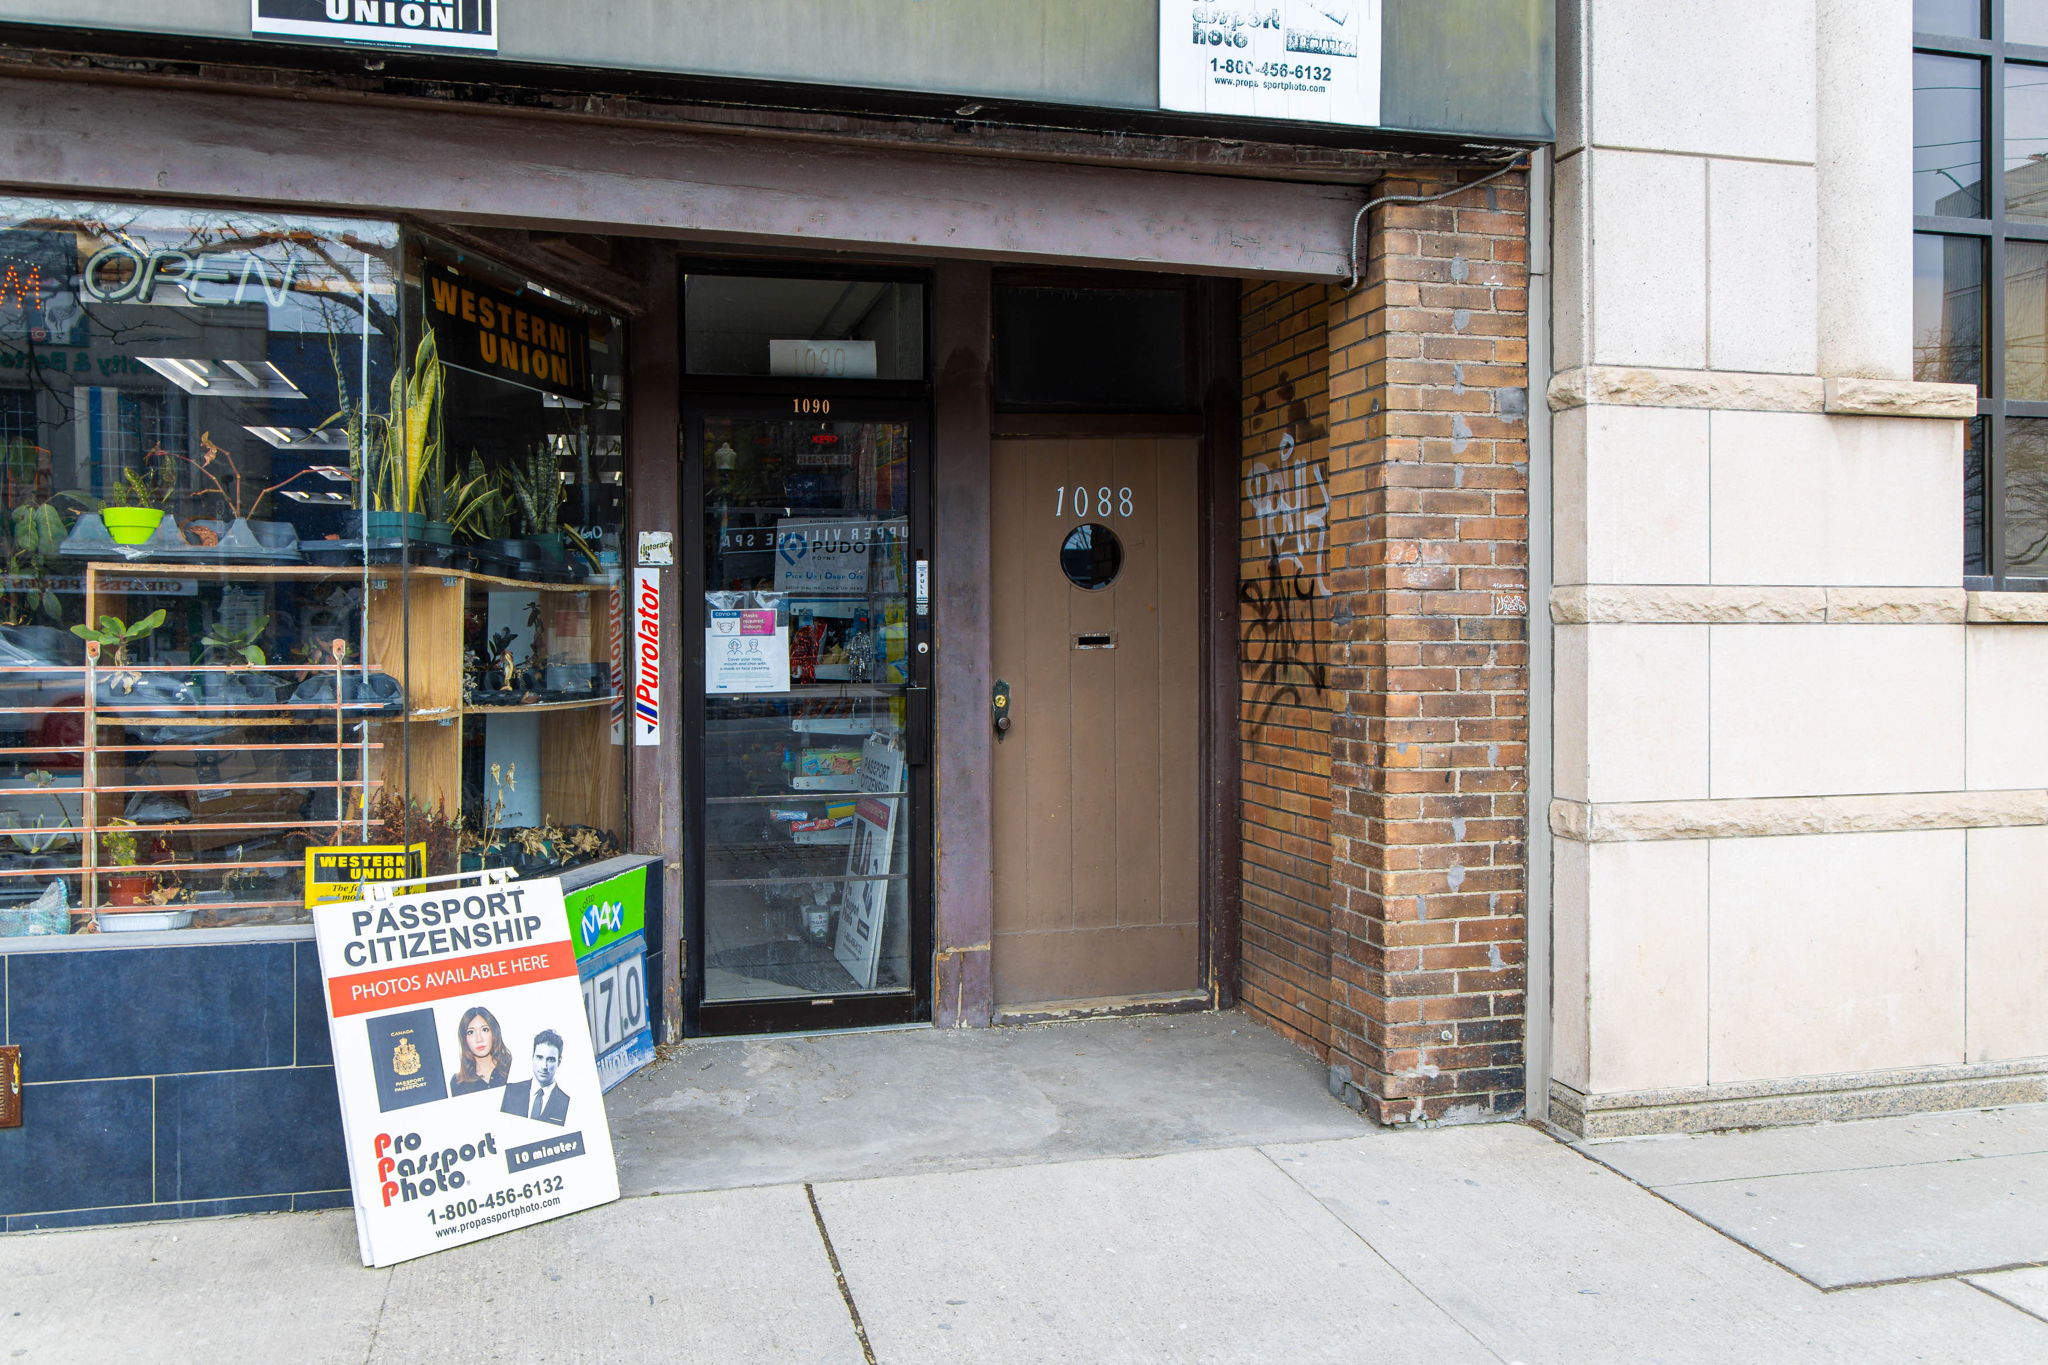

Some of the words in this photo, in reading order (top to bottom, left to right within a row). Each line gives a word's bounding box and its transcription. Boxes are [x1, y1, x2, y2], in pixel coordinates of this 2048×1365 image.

[326, 0, 454, 30] UNION
[84, 247, 298, 308] OPEN
[431, 276, 566, 354] WESTERN
[479, 329, 569, 386] UNION
[793, 398, 830, 414] 1090
[1055, 486, 1134, 518] 1088
[812, 540, 866, 554] PUDO
[636, 578, 660, 707] Purolator
[319, 855, 406, 868] WESTERN
[350, 867, 406, 880] UNION
[332, 884, 350, 892] The
[351, 889, 526, 937] PASSPORT
[581, 900, 623, 947] MAX
[343, 915, 542, 968] CITIZENSHIP
[351, 974, 421, 1001] PHOTOS
[425, 960, 508, 989] AVAILABLE
[510, 953, 550, 974] HERE
[390, 1028, 415, 1038] CANADA
[373, 1132, 422, 1159] Pro
[377, 1132, 498, 1183] Passport
[514, 1151, 529, 1165] 10
[532, 1139, 578, 1161] minutes
[381, 1168, 466, 1208] Photo
[426, 1174, 564, 1226] 1-800-456-6132
[434, 1195, 561, 1239] www.propassportphoto.com
